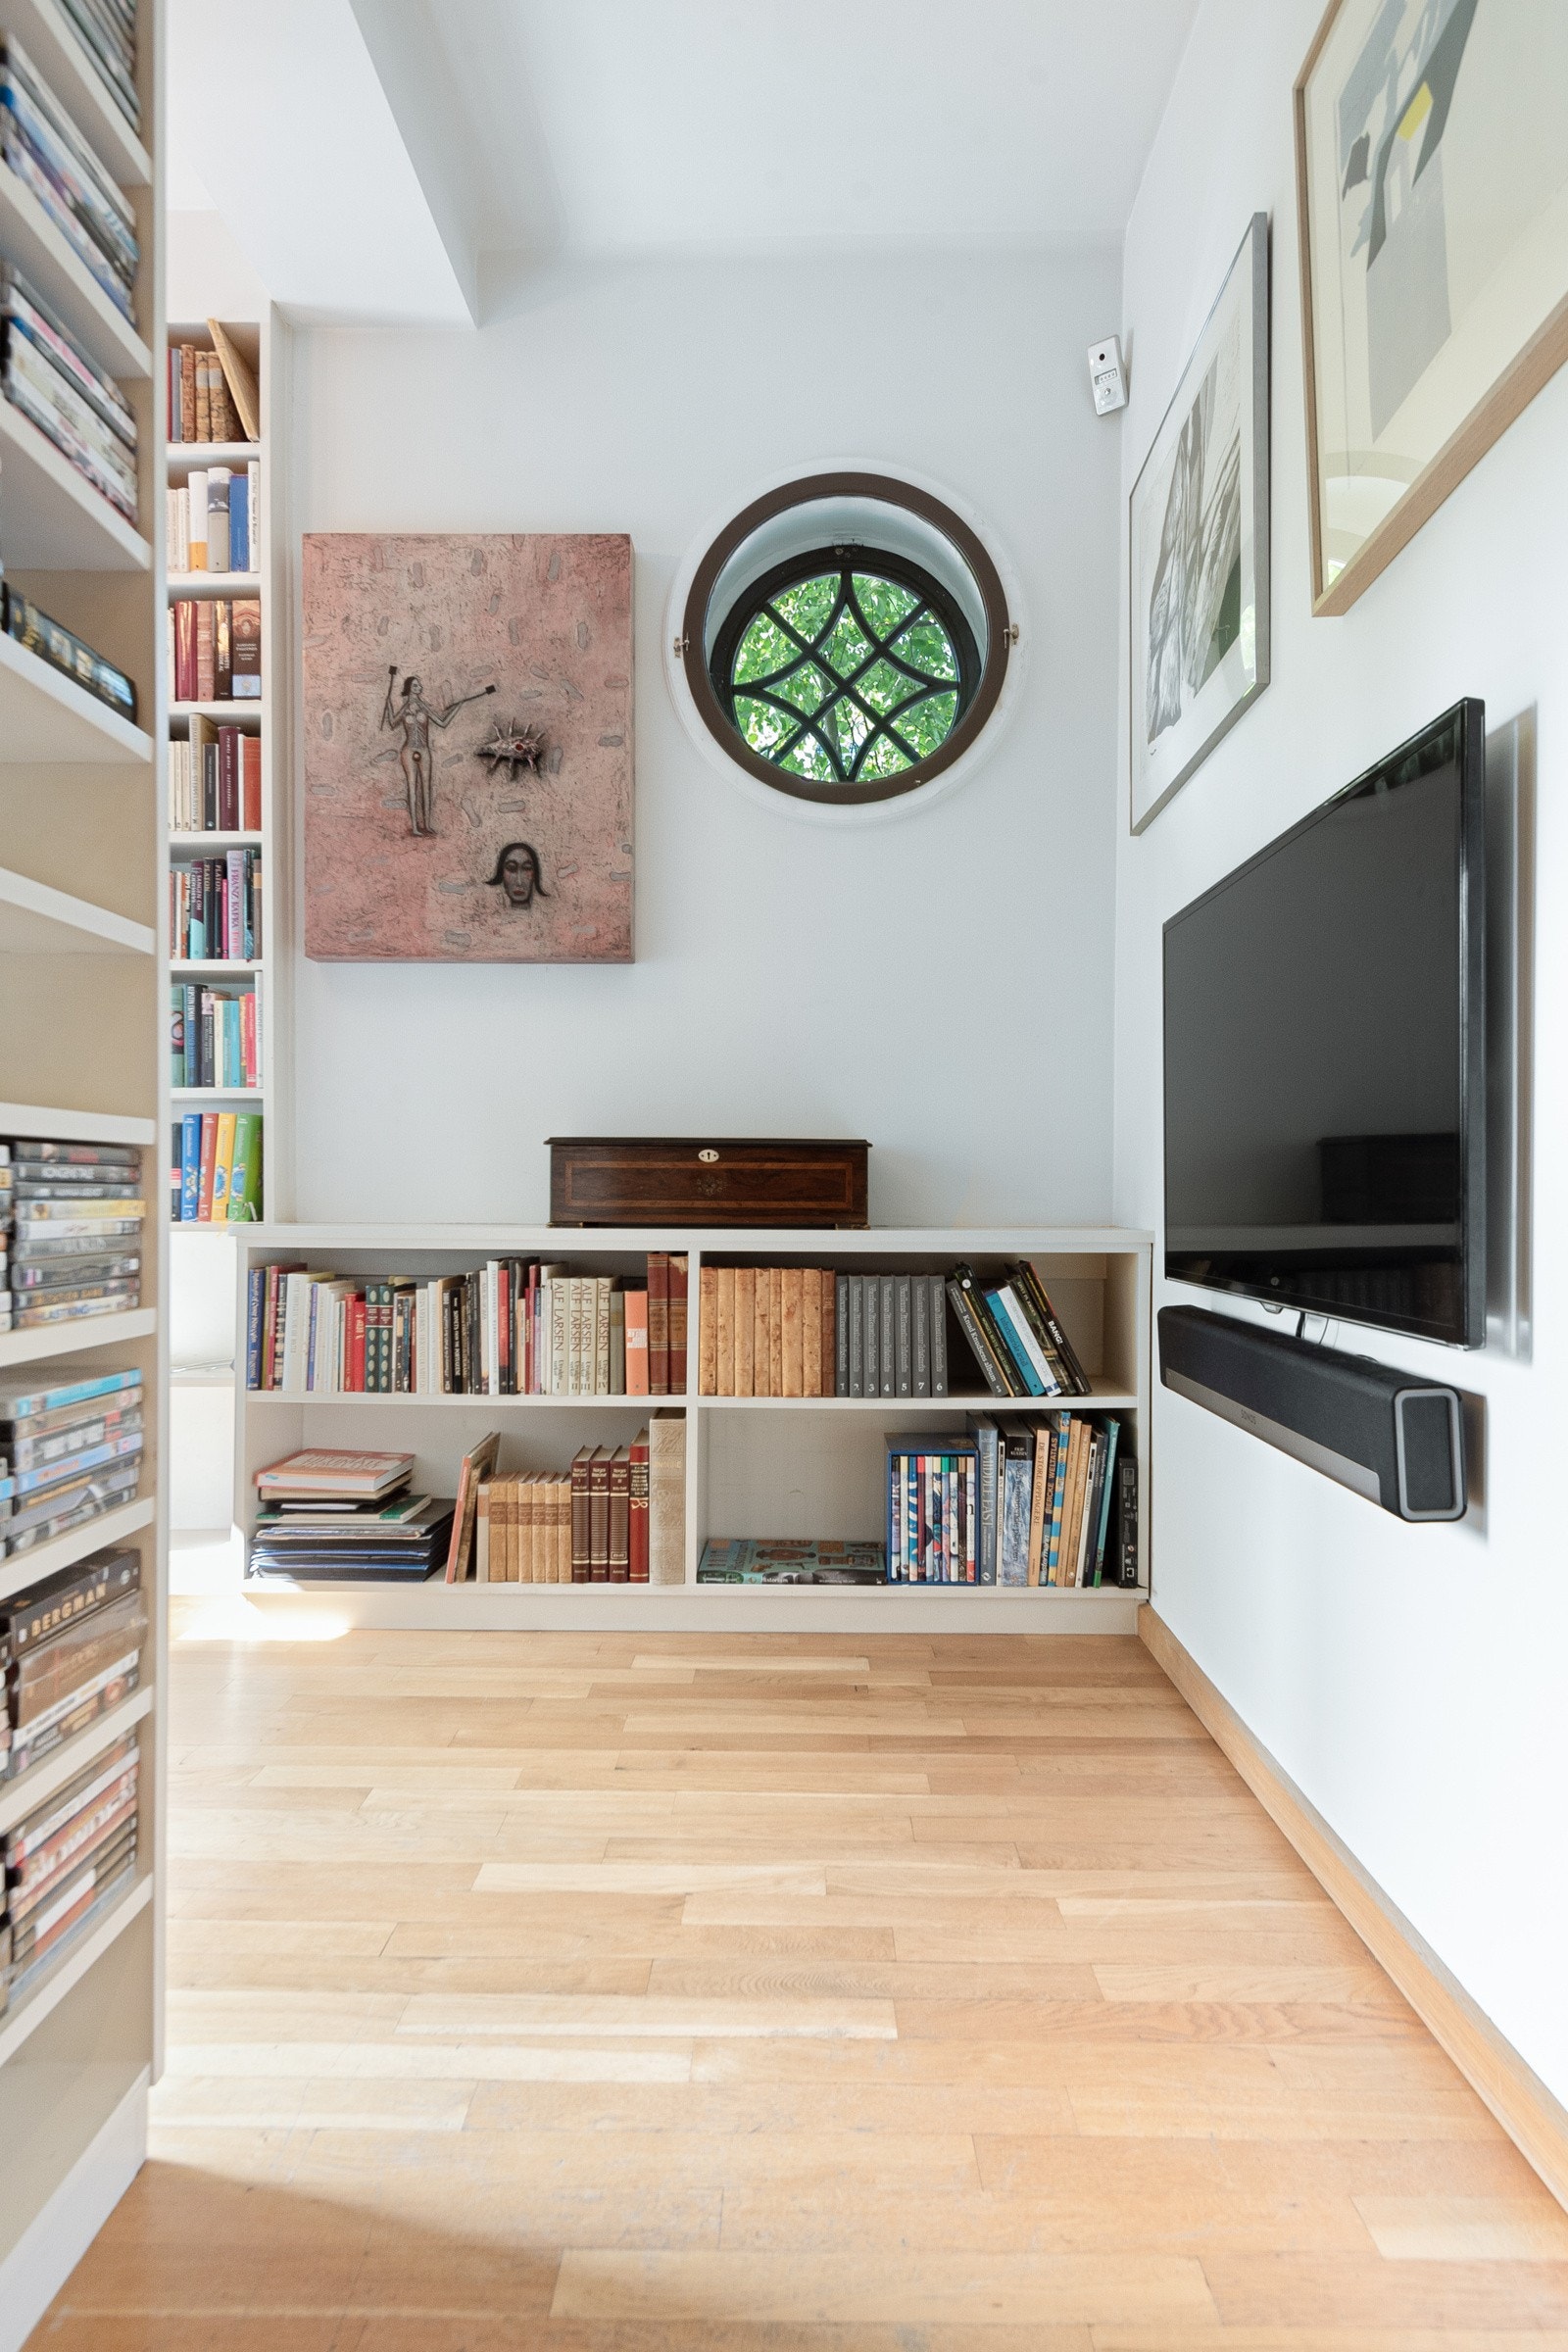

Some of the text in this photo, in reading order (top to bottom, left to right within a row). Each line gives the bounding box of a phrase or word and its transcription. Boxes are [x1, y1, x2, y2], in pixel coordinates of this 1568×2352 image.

[231, 868, 240, 900] FRANZ
[554, 1283, 564, 1351] ALF LARSEN
[570, 1284, 581, 1352] ALF LARSEN
[581, 1284, 592, 1352] ALF LARSEN
[598, 1283, 610, 1351] ALF LARSEN
[961, 1314, 1000, 1383] Knud Knudsens album
[1047, 1319, 1065, 1346] BANG!
[982, 1451, 995, 1529] MIDDLE EAST
[1033, 1442, 1046, 1527] DE STORE OPPDAGERE
[1040, 1534, 1051, 1583] westermann
[1048, 1437, 1058, 1479] WELTATLAS
[31, 1582, 108, 1636] BERGMAN
